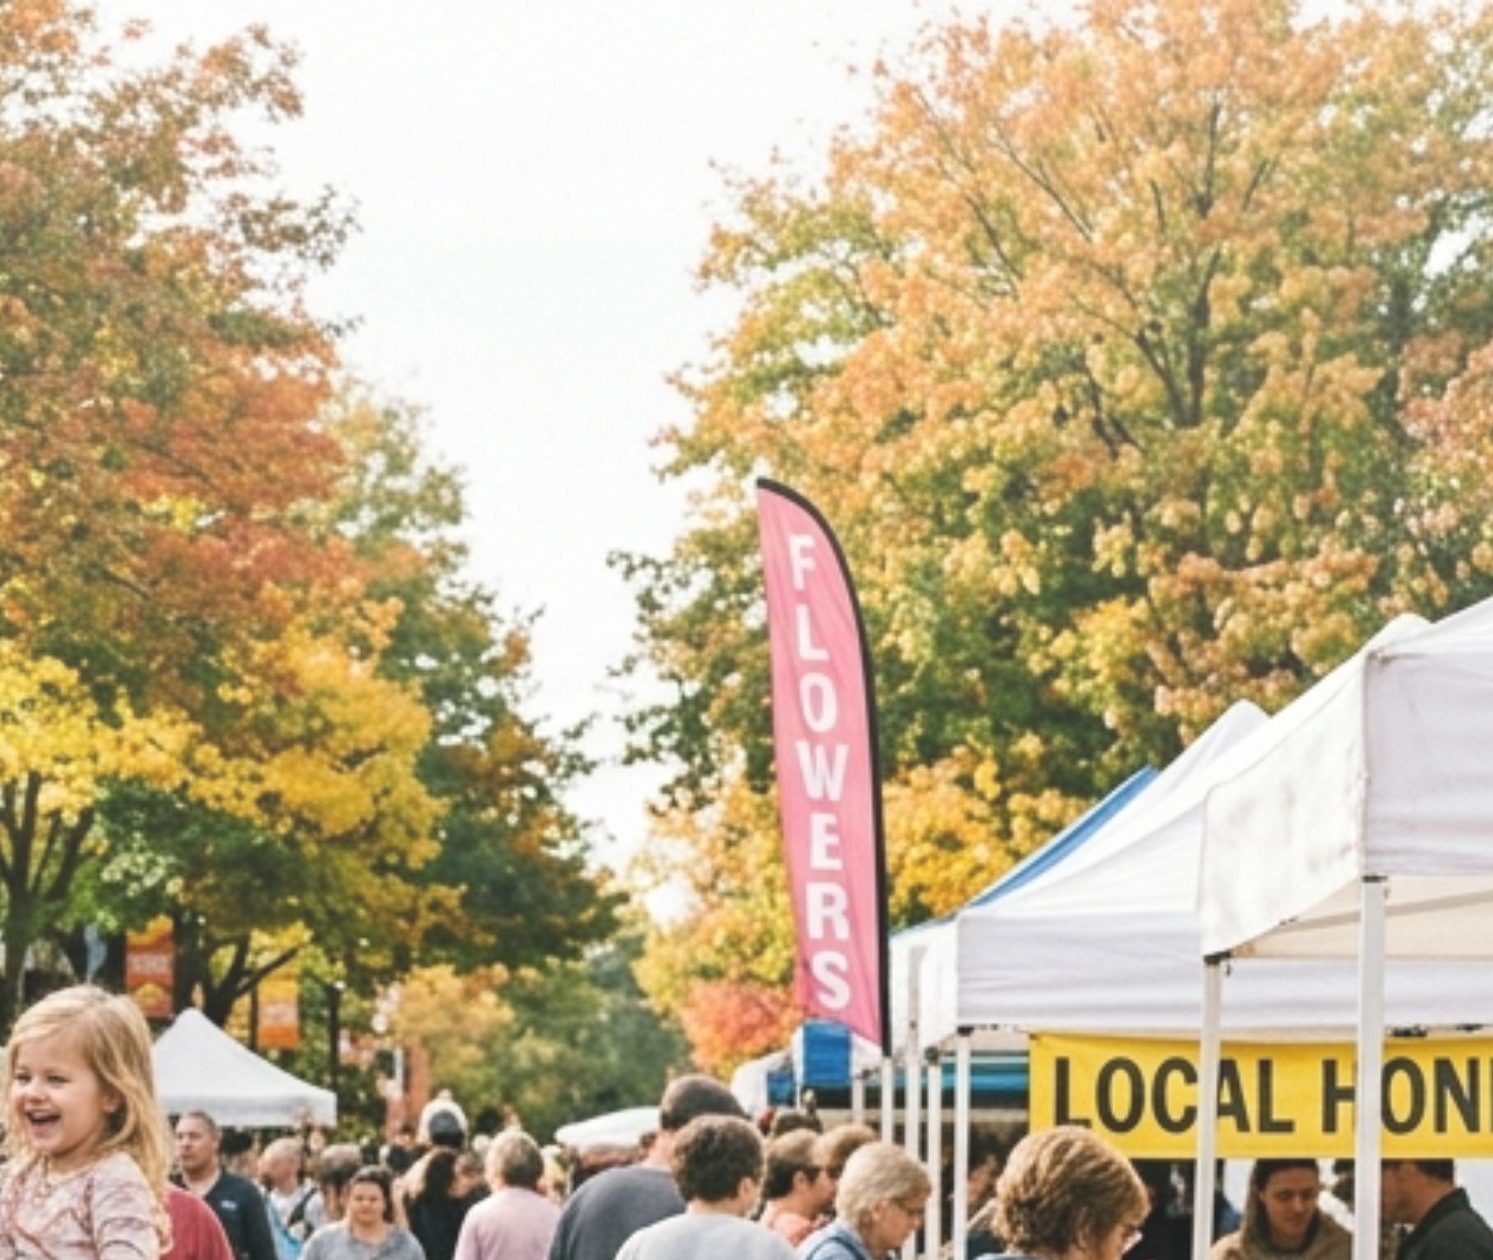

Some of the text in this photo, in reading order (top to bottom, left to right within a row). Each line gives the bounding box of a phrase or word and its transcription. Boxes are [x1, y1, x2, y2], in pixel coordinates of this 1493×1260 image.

[788, 534, 851, 1011] FLOWERS
[1054, 1057, 1493, 1134] LOCAL HON
